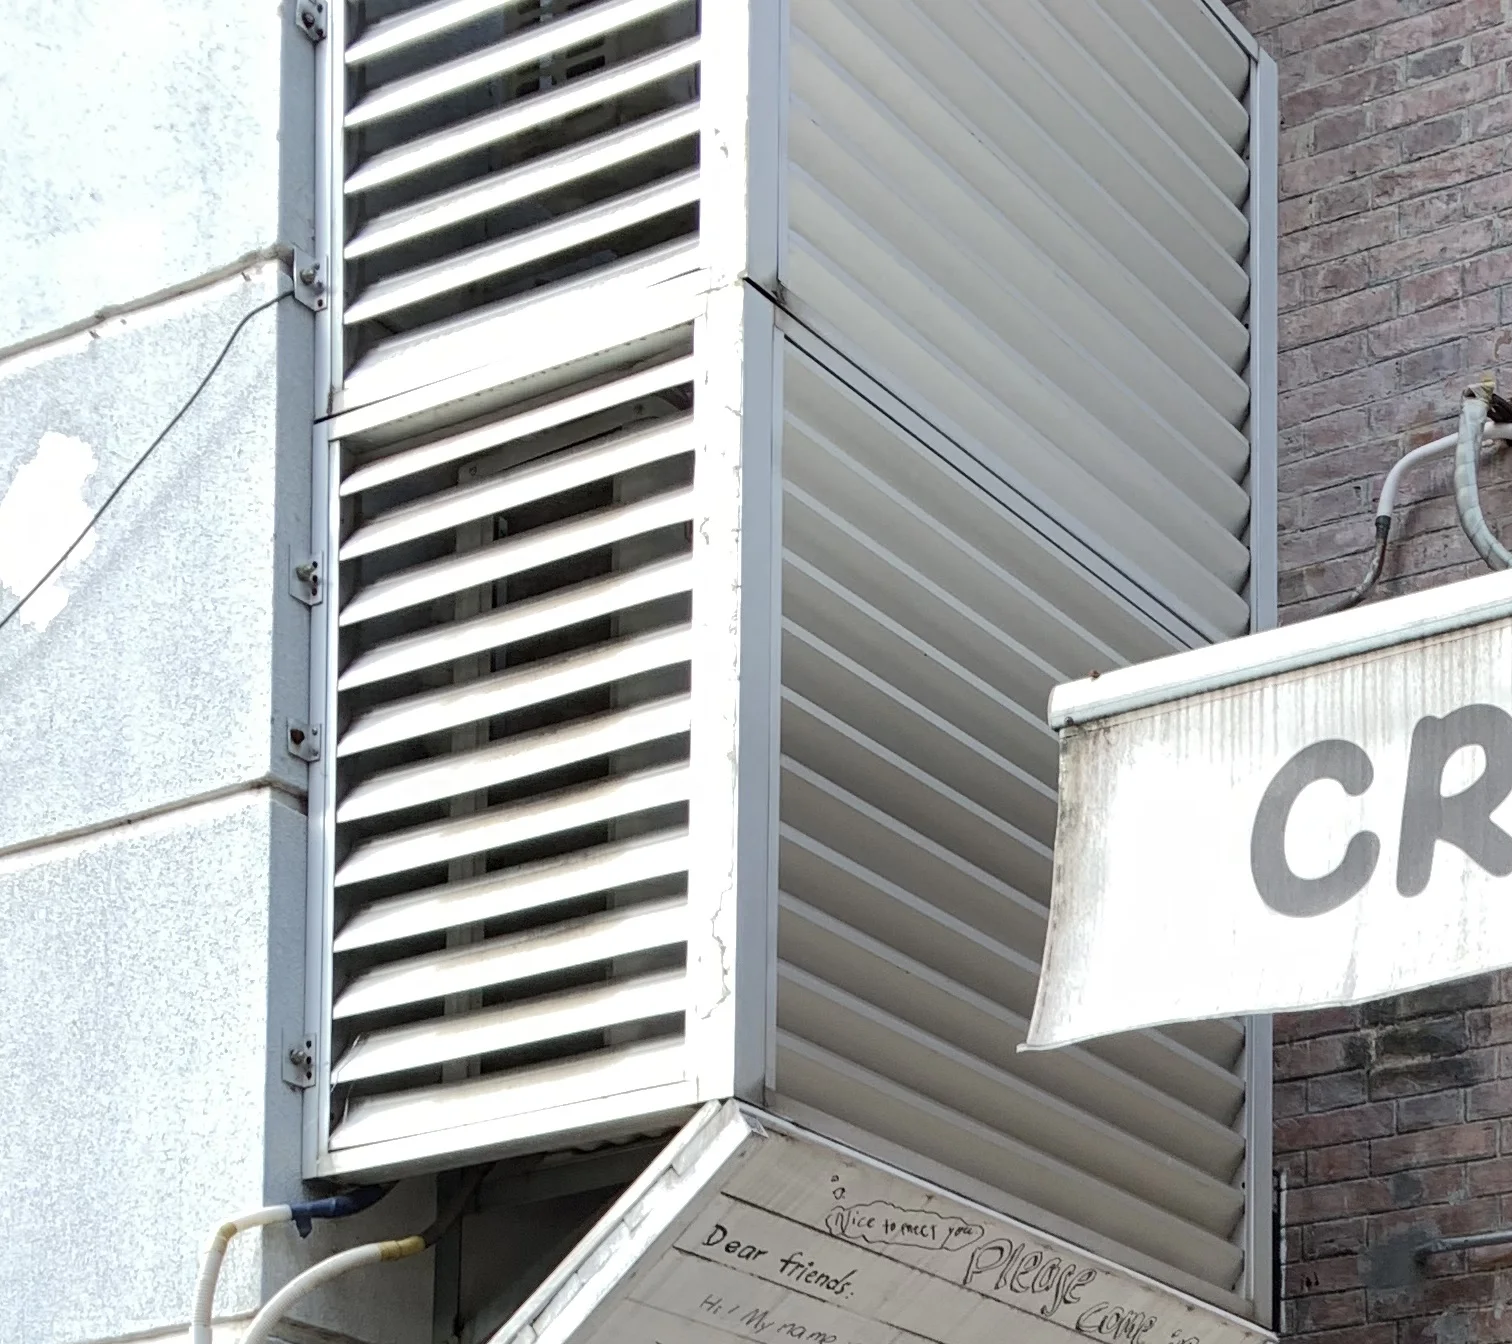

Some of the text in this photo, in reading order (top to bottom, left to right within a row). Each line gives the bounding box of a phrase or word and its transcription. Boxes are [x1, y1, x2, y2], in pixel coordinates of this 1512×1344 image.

[834, 1210, 876, 1236] Nice
[882, 1218, 897, 1235] to
[702, 1223, 770, 1261] Dear
[741, 1307, 774, 1332] My
